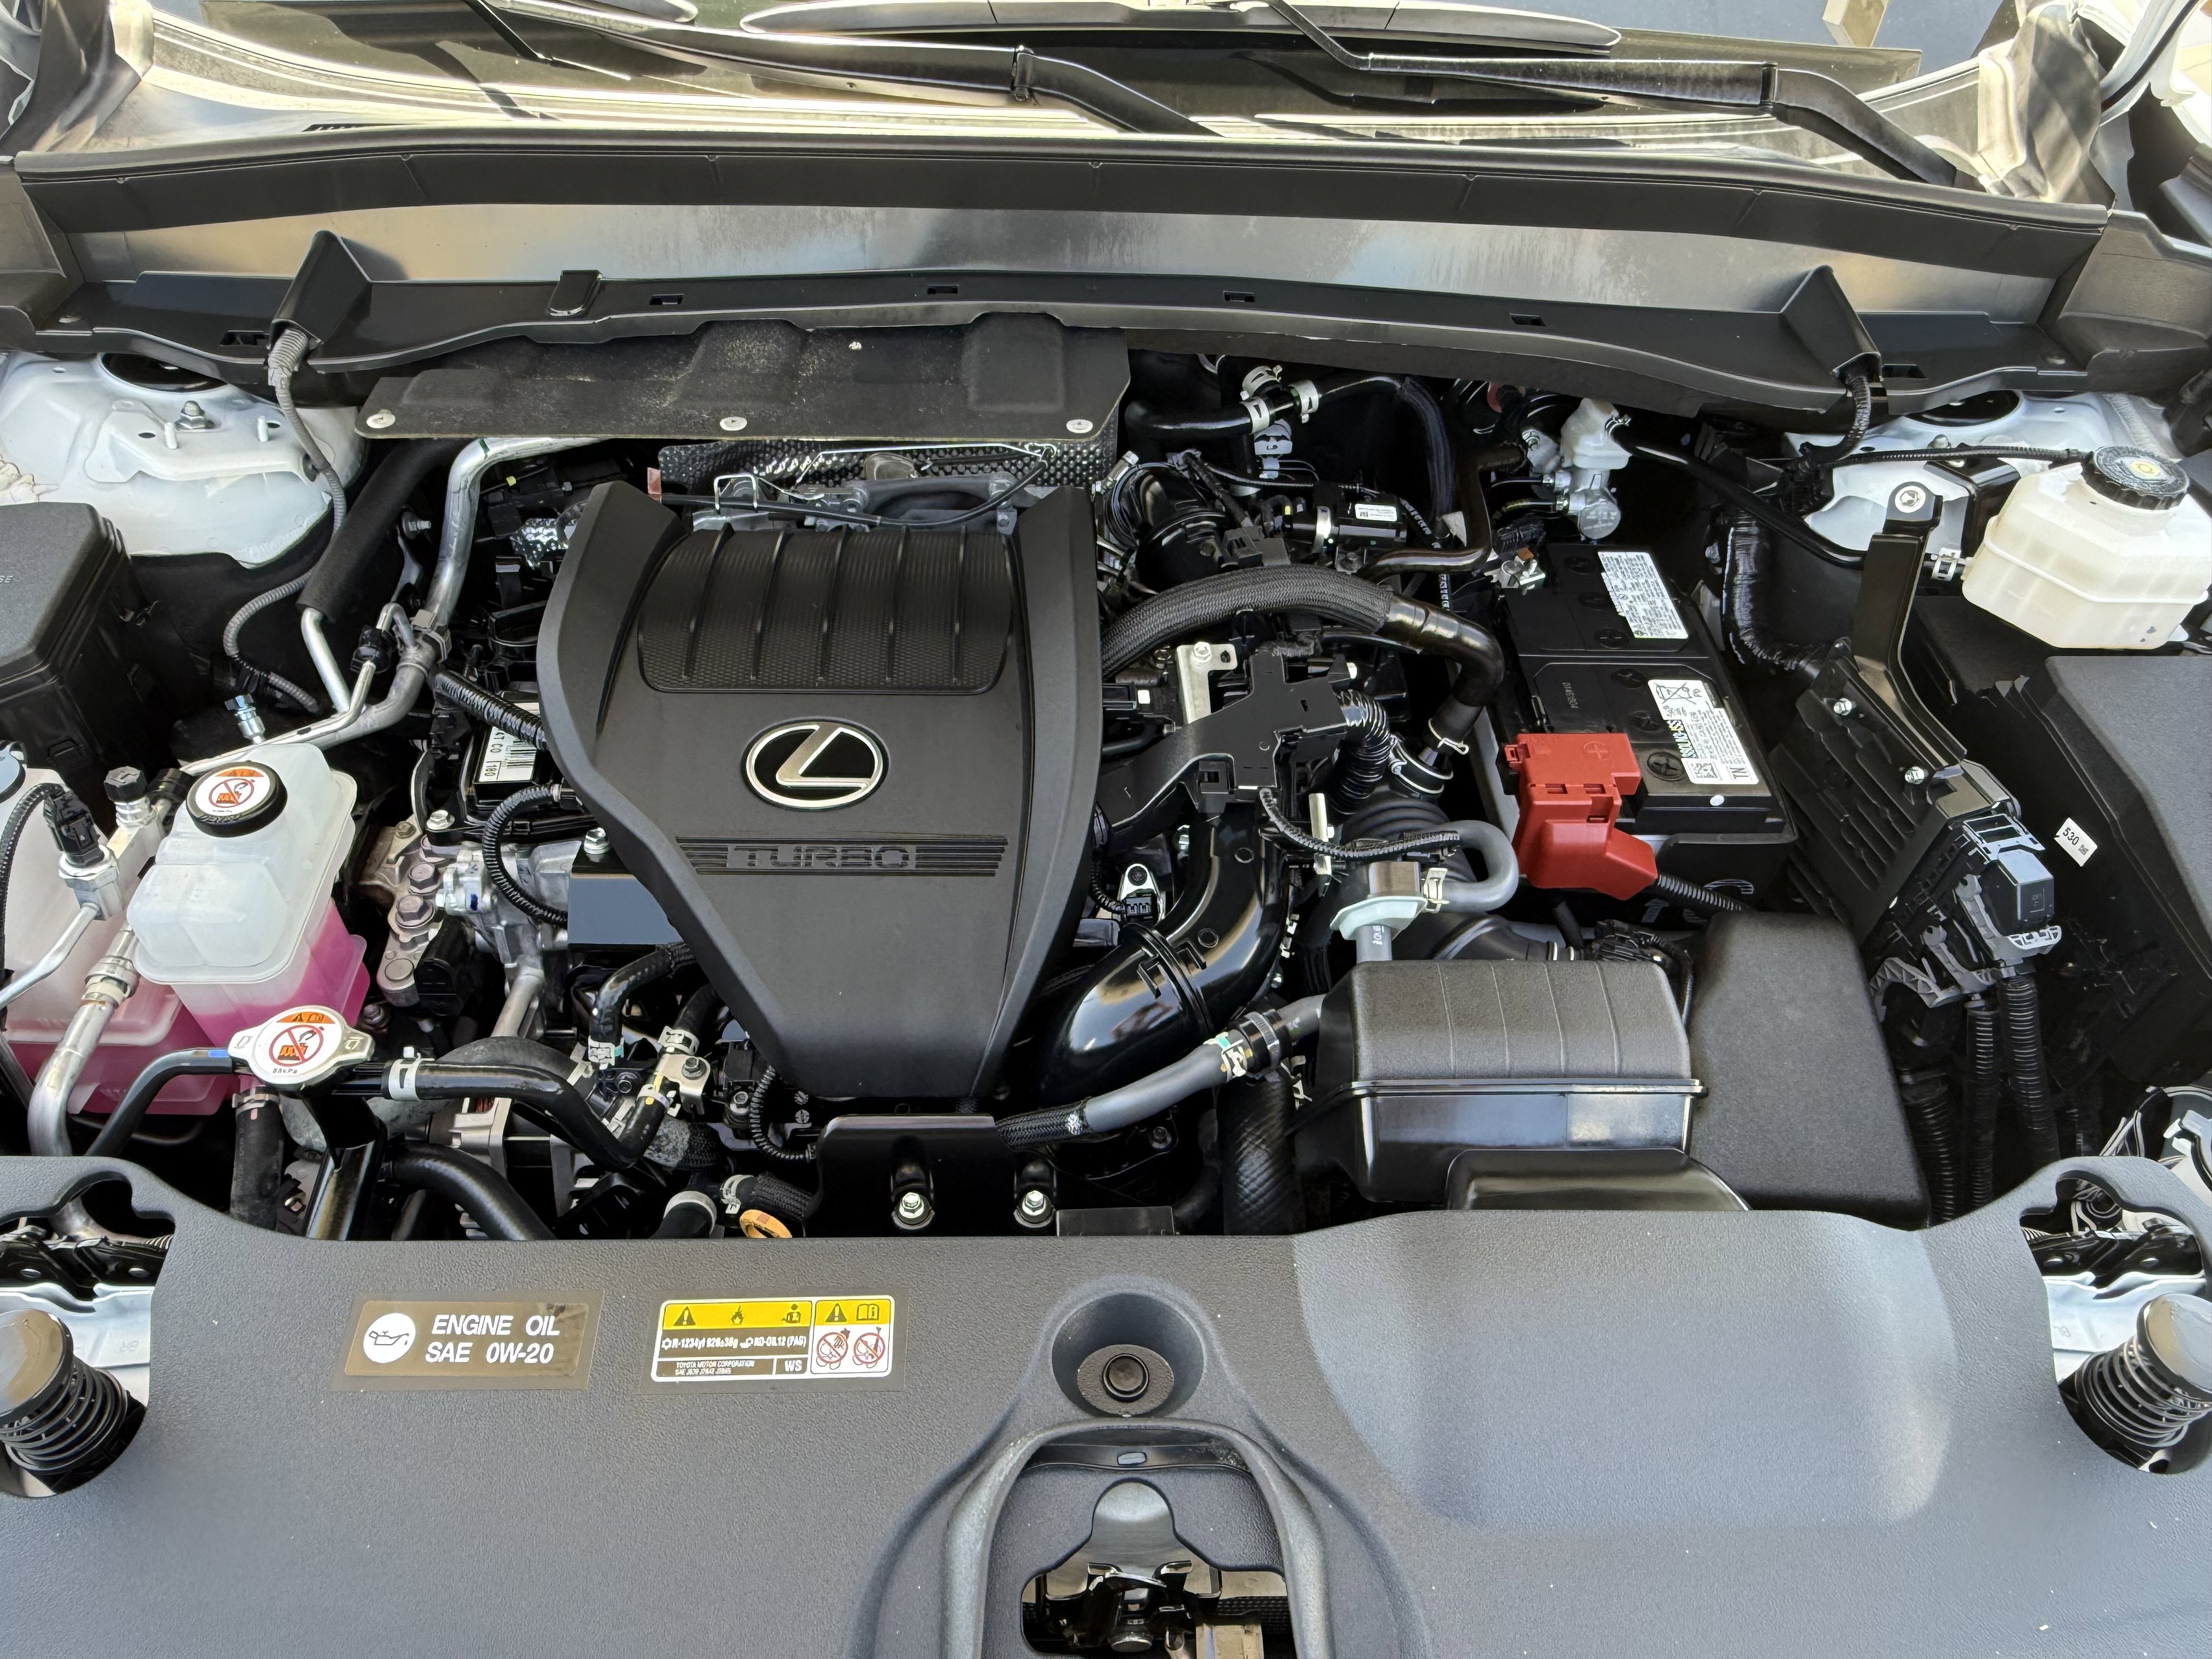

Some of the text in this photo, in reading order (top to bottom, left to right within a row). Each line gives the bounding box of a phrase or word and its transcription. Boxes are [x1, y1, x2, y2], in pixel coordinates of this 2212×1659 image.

[484, 765, 498, 776] 180
[2063, 827, 2080, 845] 530
[733, 846, 910, 868] TURBO
[431, 1314, 560, 1336] ENGINE OIL
[425, 1342, 555, 1364] SAE 0W-20
[785, 1360, 803, 1372] WS
